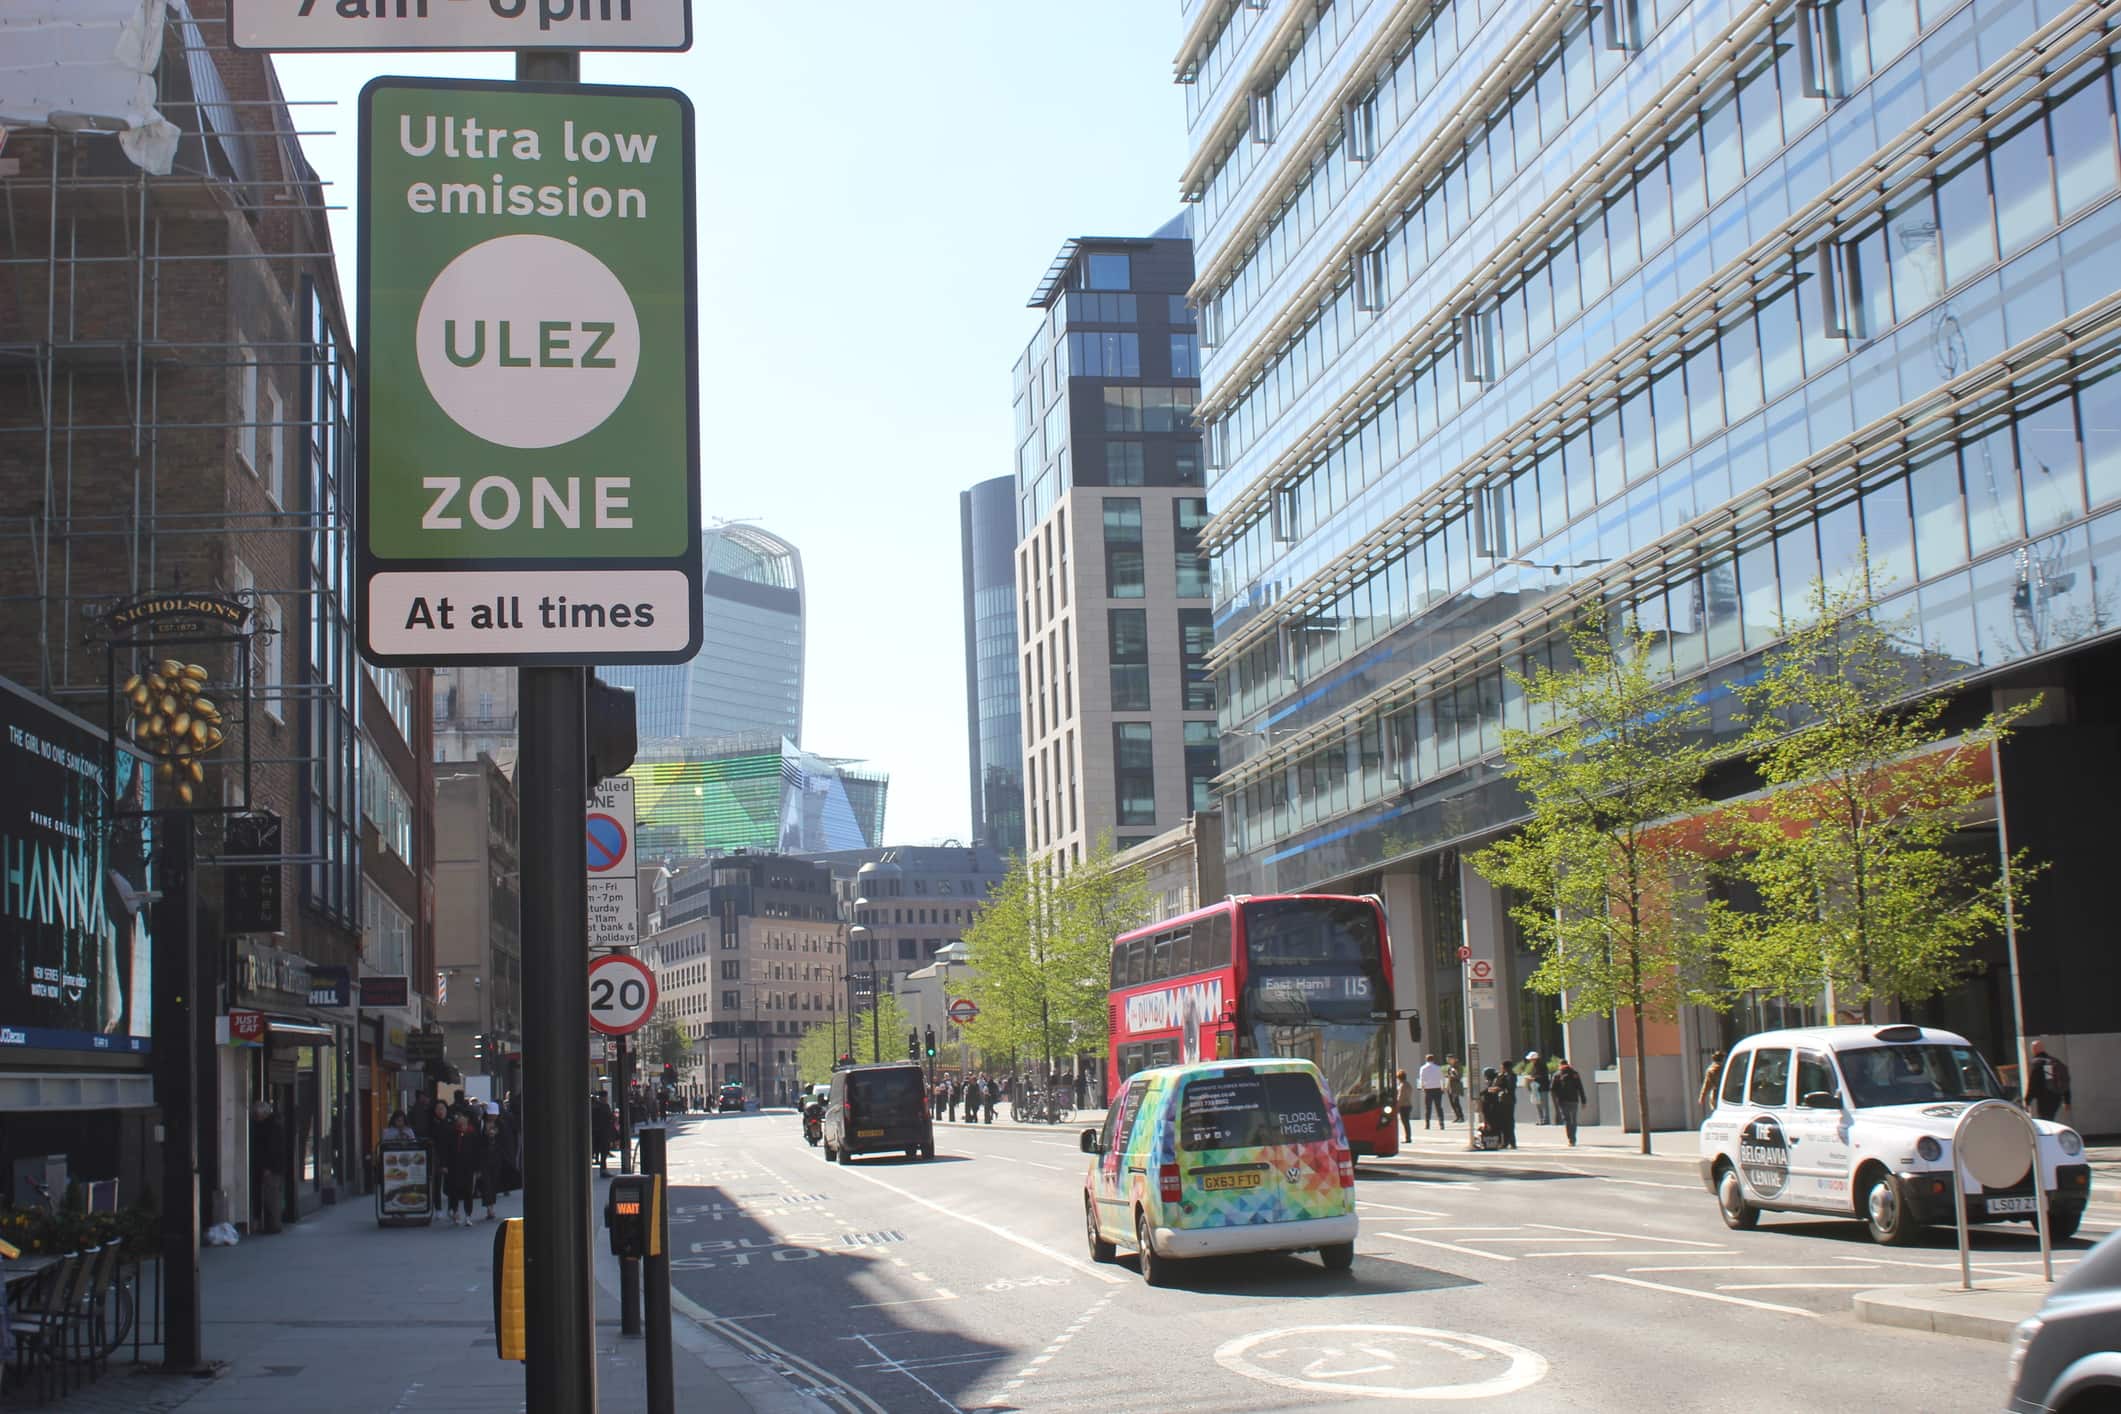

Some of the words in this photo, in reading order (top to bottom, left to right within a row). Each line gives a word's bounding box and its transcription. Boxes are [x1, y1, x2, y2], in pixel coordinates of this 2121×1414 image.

[400, 114, 542, 161] Ultra
[564, 120, 659, 163] low
[407, 173, 648, 219] emission
[444, 319, 617, 369] ULEZ
[421, 475, 634, 531] ZONE
[113, 600, 240, 624] NICHOLSON'S
[404, 596, 455, 630] At
[470, 595, 524, 630] all
[538, 595, 656, 629] times
[9, 724, 24, 748] THE
[25, 732, 40, 756] GIRL
[41, 738, 51, 761] NO
[52, 744, 66, 767] ONE
[597, 780, 630, 793] olled
[30, 809, 52, 829] PRIME
[3, 833, 109, 939] HANNA
[602, 893, 624, 904] 7pm
[590, 904, 620, 914] turday
[601, 923, 623, 932] bank
[596, 932, 636, 943] holidays
[590, 978, 646, 1012] 20
[1266, 977, 1291, 991] East
[1344, 977, 1369, 997] 115
[308, 989, 339, 1005] HILL
[234, 1015, 260, 1025] JUST
[239, 1024, 259, 1034] EAT
[1278, 1111, 1322, 1125] FLORAL
[1755, 1122, 1771, 1140] THE
[1740, 1142, 1789, 1166] BELGRAVIA
[1750, 1170, 1783, 1188] CENTRE
[615, 1202, 641, 1216] WAIT
